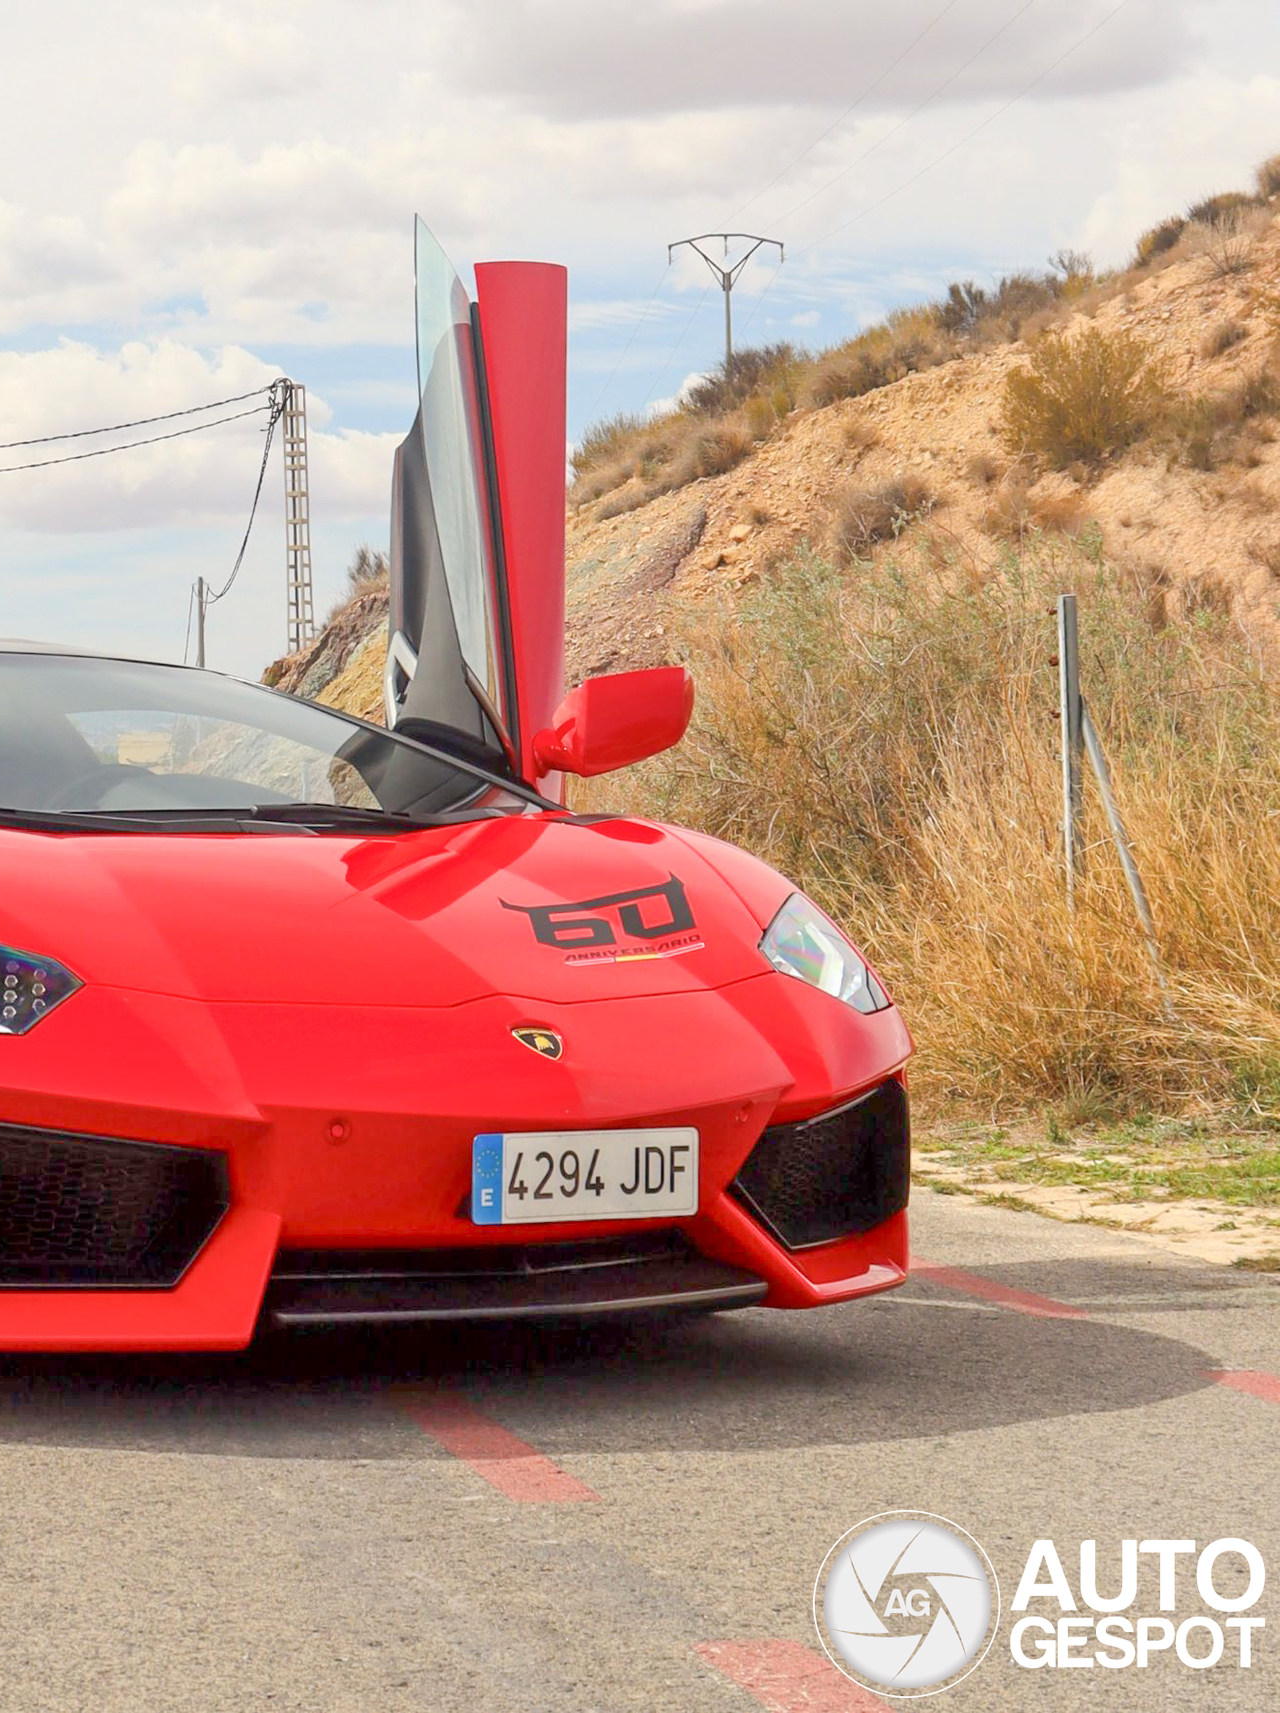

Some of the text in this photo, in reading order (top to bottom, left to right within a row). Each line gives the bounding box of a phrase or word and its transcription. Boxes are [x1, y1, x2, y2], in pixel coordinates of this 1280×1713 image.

[498, 871, 696, 949] 60
[564, 934, 701, 961] ANNIVERSARIO
[507, 1145, 690, 1201] 4294 JDF
[480, 1188, 494, 1207] E
